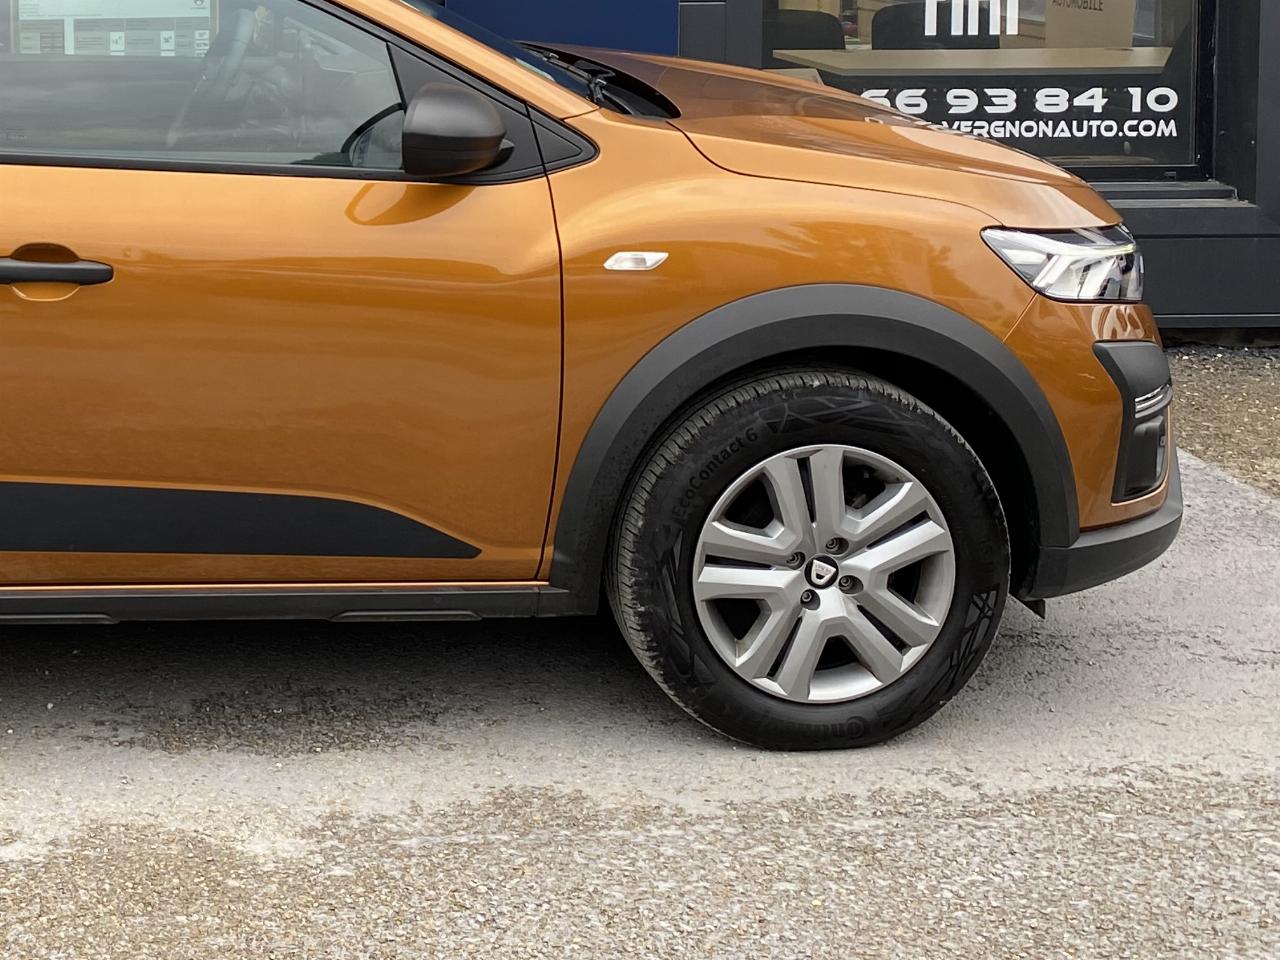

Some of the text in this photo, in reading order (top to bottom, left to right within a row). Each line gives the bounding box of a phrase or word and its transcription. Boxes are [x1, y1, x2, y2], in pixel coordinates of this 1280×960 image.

[946, 88, 1017, 114] 93
[1035, 87, 1108, 113] 84
[1128, 87, 1178, 112] 10
[672, 427, 758, 522] EcoContact 6
